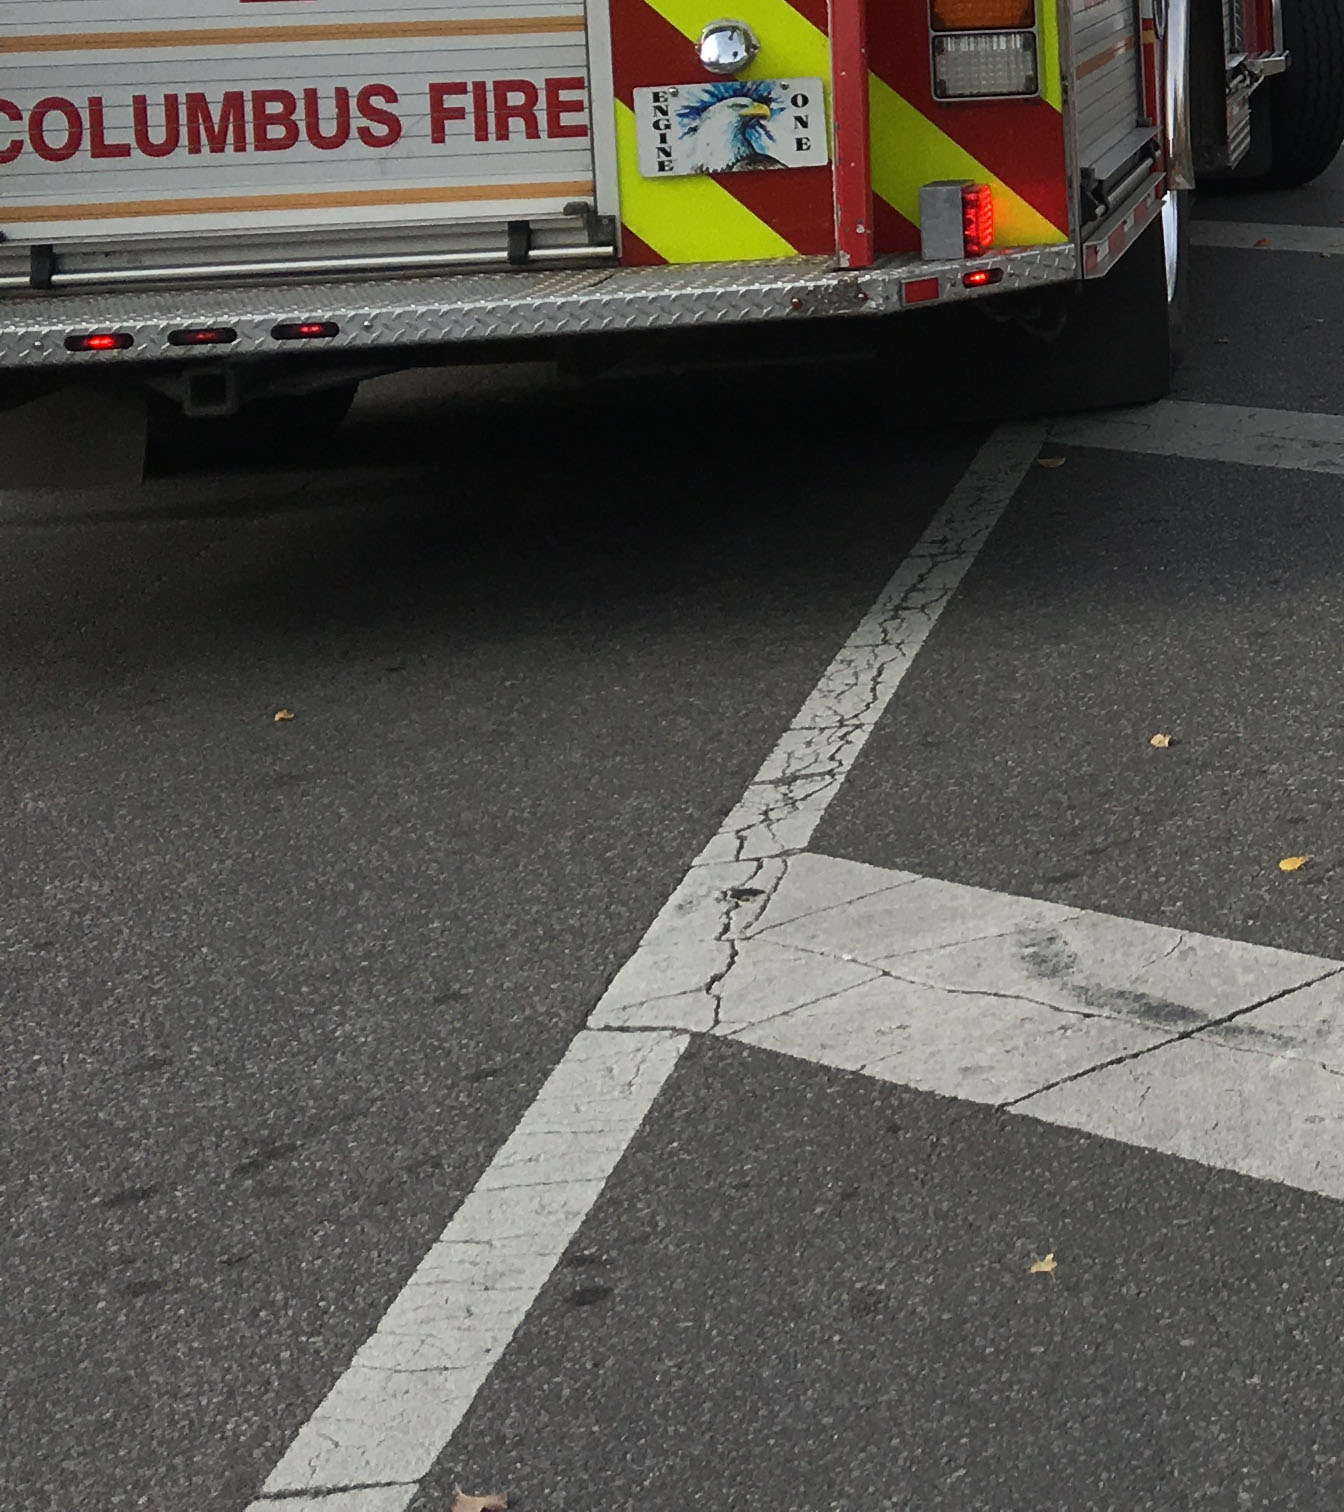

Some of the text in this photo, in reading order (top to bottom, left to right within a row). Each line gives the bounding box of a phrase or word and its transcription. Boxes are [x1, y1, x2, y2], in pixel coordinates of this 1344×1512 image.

[429, 77, 588, 144] FIRE
[652, 90, 674, 172] ENGINE
[790, 93, 812, 152] ONE
